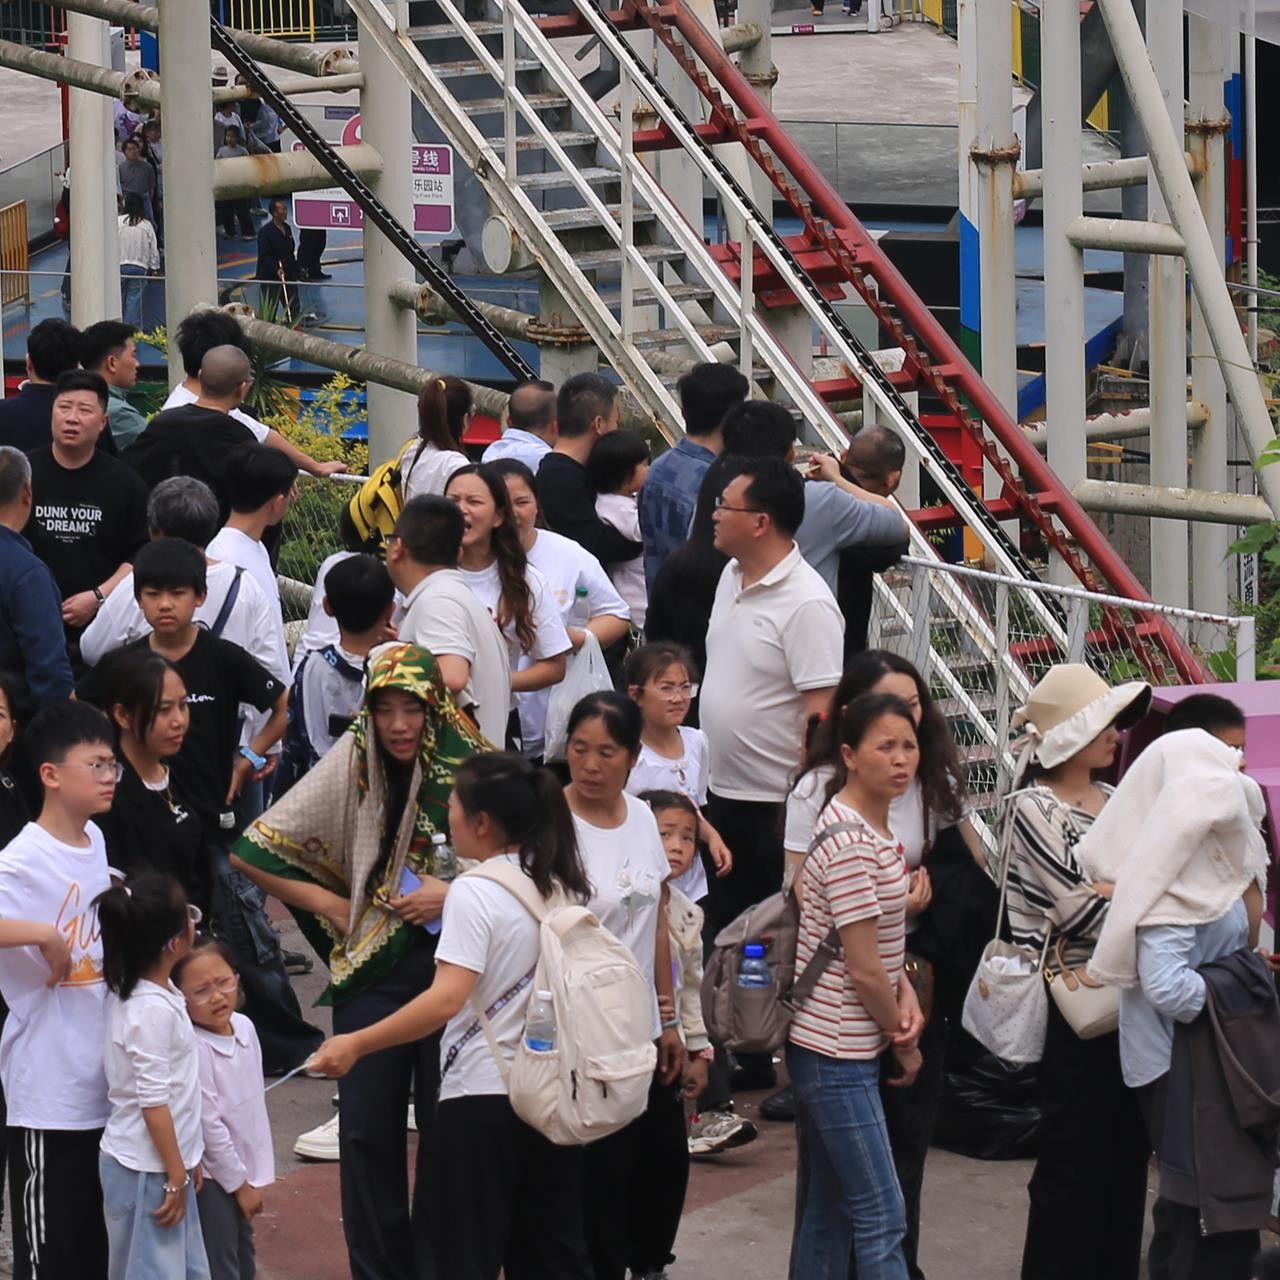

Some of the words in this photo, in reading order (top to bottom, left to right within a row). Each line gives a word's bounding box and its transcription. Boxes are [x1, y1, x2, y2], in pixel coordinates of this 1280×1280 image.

[35, 505, 68, 519] DUNK
[70, 507, 103, 522] YOUR
[46, 519, 90, 534] DREAMS
